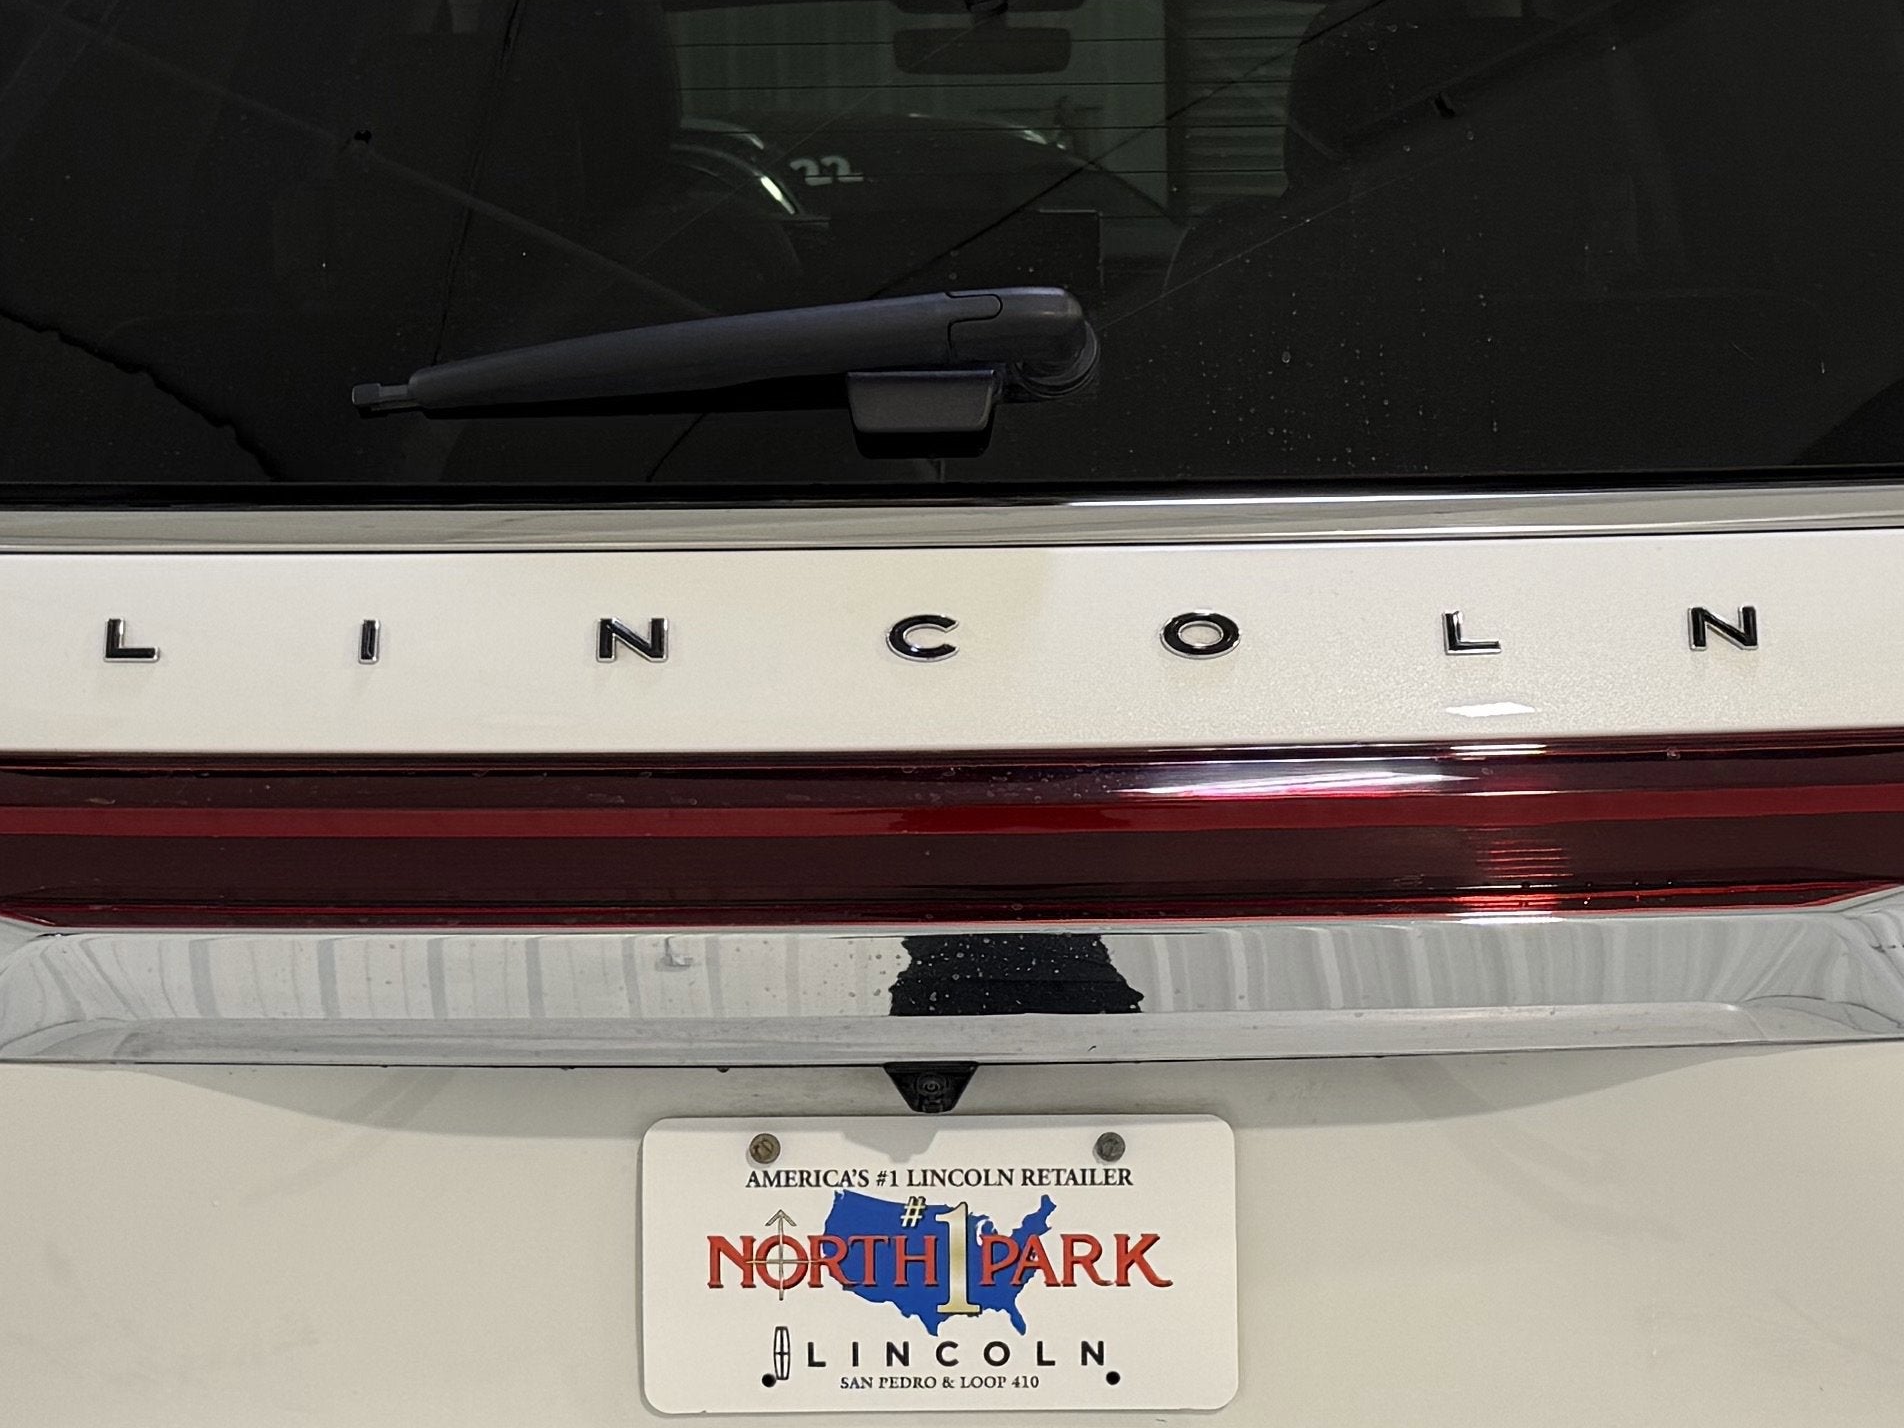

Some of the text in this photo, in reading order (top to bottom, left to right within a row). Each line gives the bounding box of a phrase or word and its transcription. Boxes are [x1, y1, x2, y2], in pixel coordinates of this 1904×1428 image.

[103, 604, 1761, 664] LINCOLN
[745, 1168, 1134, 1188] AMERICA'S #1 LINCOLN RETAILER
[707, 1233, 1174, 1290] NORTH PARK
[807, 1340, 1105, 1368] LINCOLN
[840, 1375, 1040, 1389] SAN PEDRO & LOOP 410
